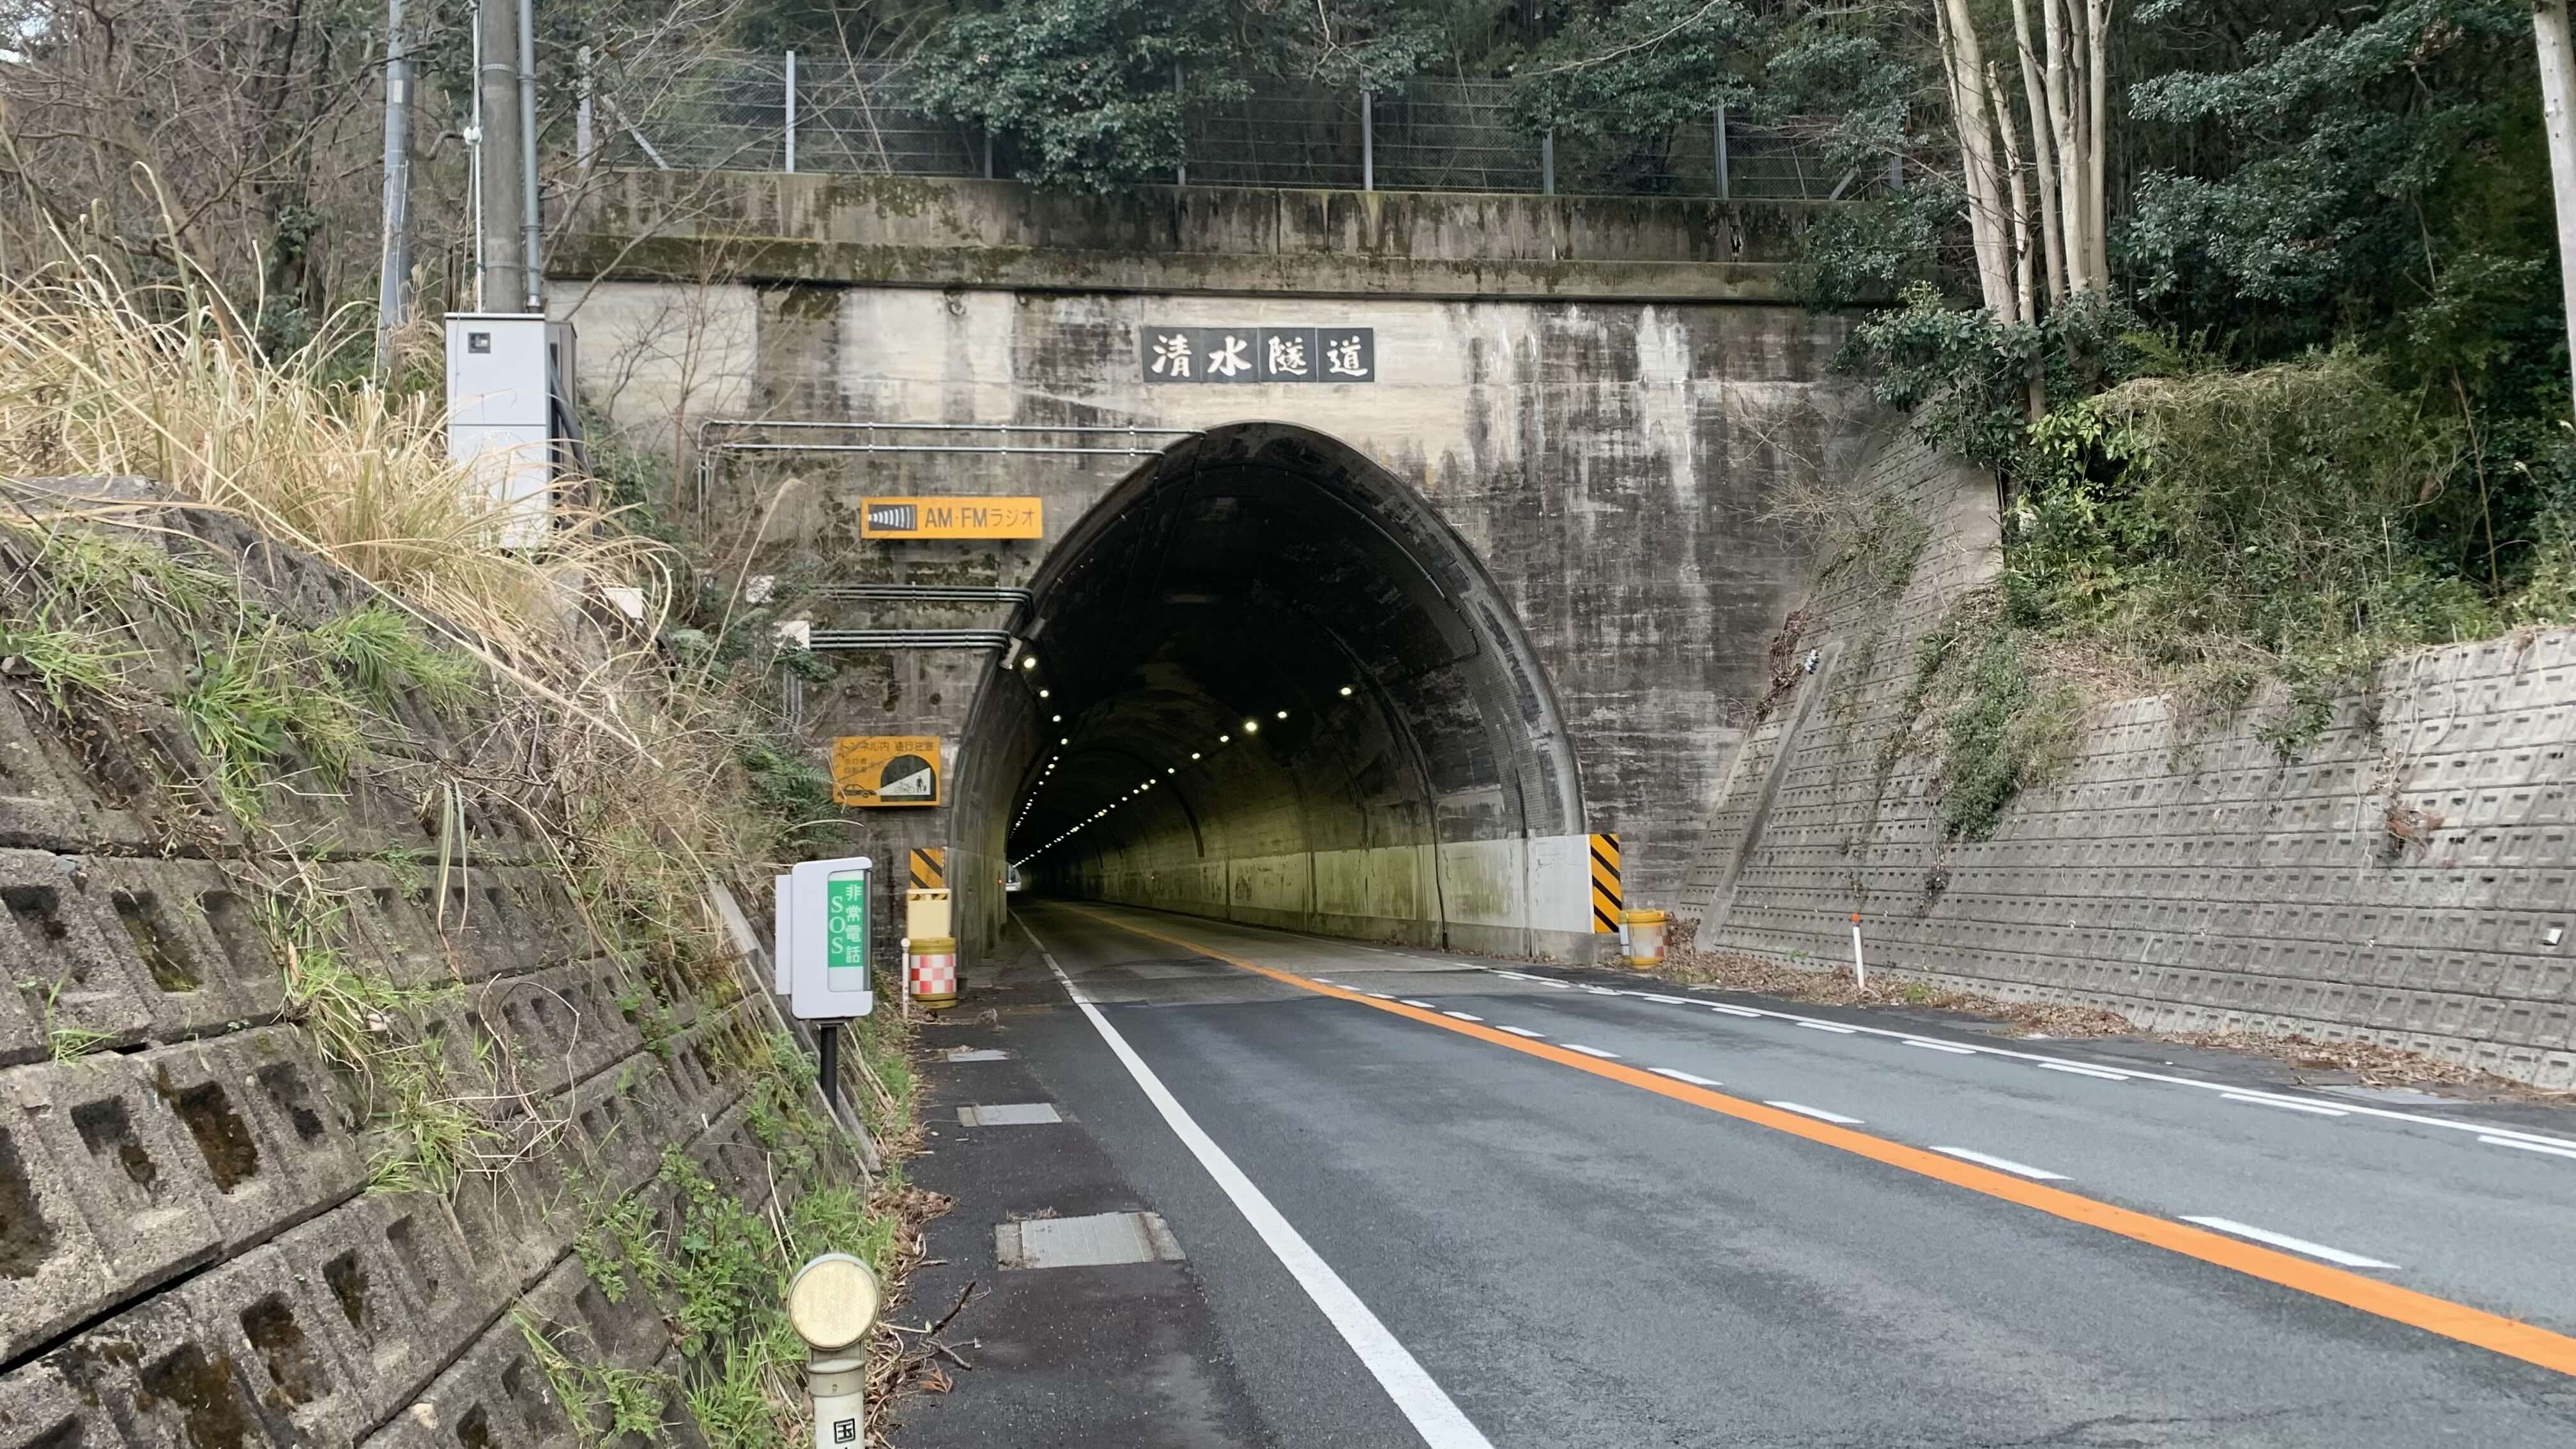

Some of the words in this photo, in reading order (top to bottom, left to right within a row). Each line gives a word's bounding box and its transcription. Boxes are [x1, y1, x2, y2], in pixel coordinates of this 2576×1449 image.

[1151, 334, 1368, 378] 清水隧道
[829, 895, 845, 954] SOS
[845, 884, 862, 964] 非常電話
[833, 1418, 855, 1449] 国
